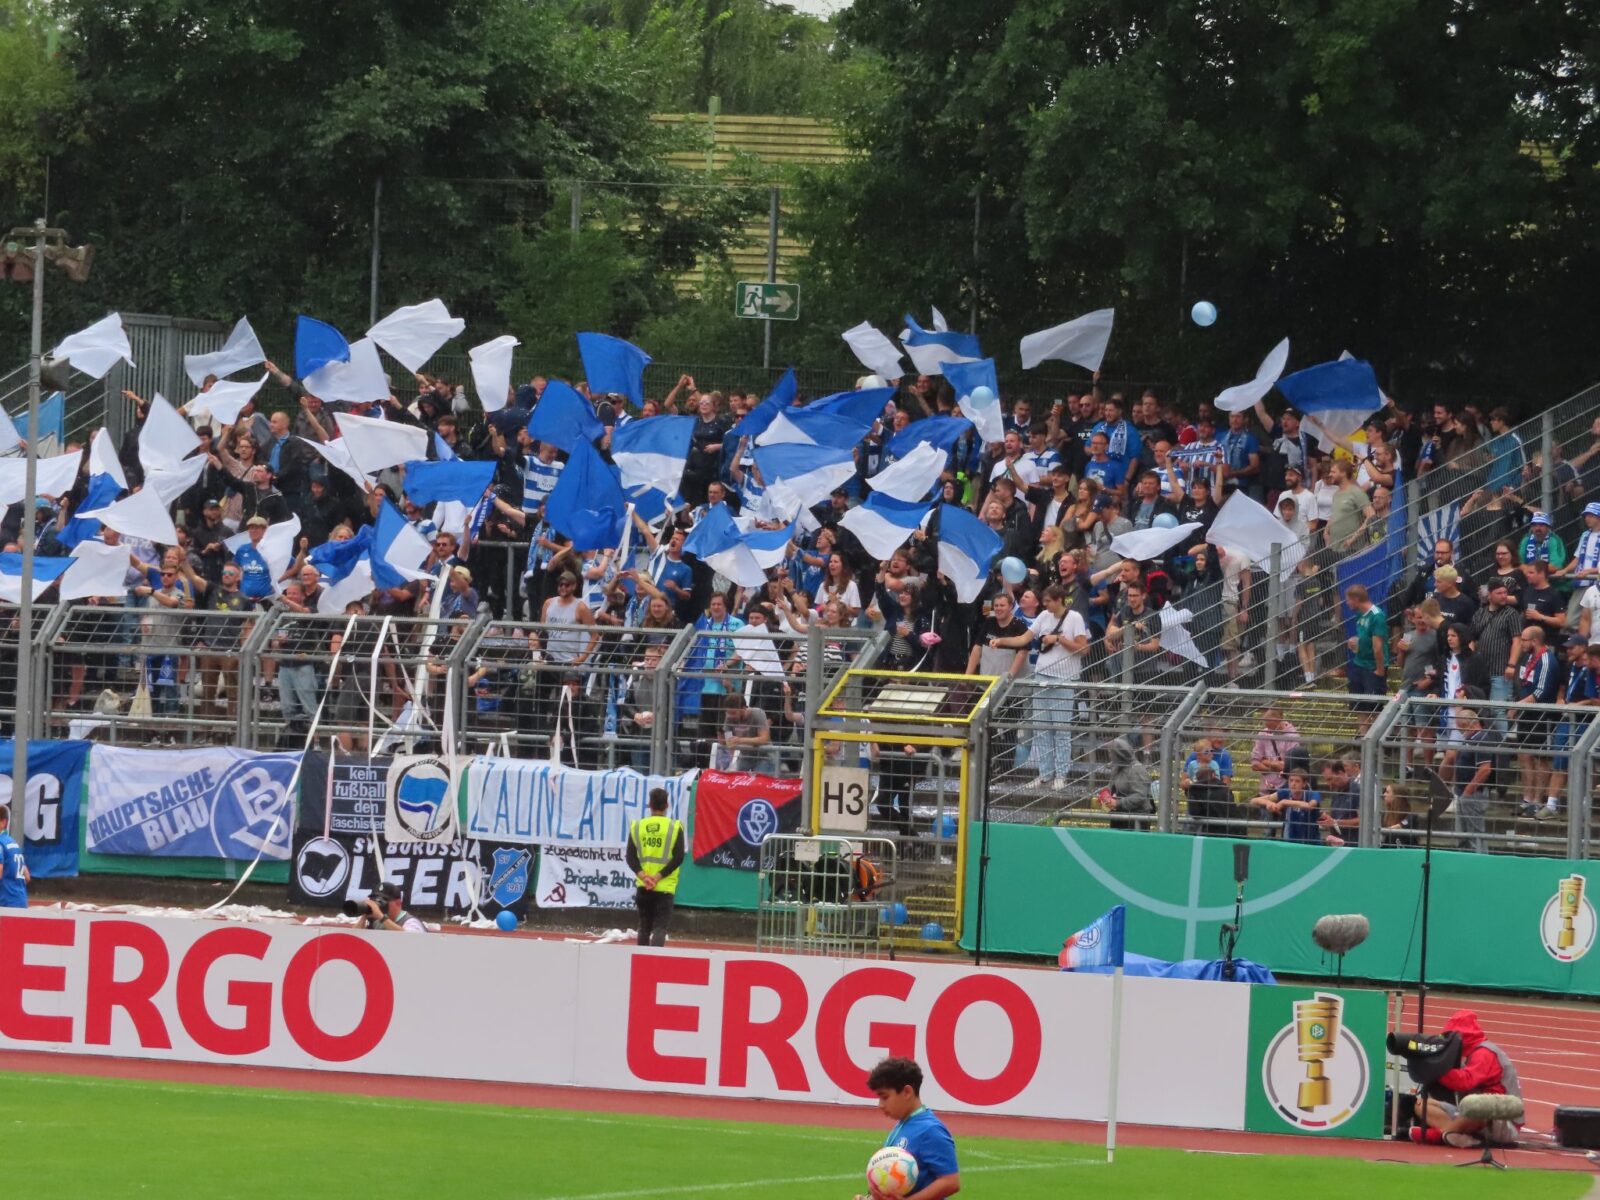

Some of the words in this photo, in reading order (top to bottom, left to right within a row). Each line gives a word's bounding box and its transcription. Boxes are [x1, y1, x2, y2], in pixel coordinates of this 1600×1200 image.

[335, 782, 386, 799] fußball
[349, 766, 377, 780] kein
[89, 766, 215, 843] HAUPTSACHE
[354, 802, 379, 813] den
[823, 781, 864, 816] H3
[141, 797, 210, 850] BLAU
[386, 839, 481, 859] BORUSSIA
[0, 917, 394, 1062] ERGO
[626, 953, 1042, 1106] ERGO
